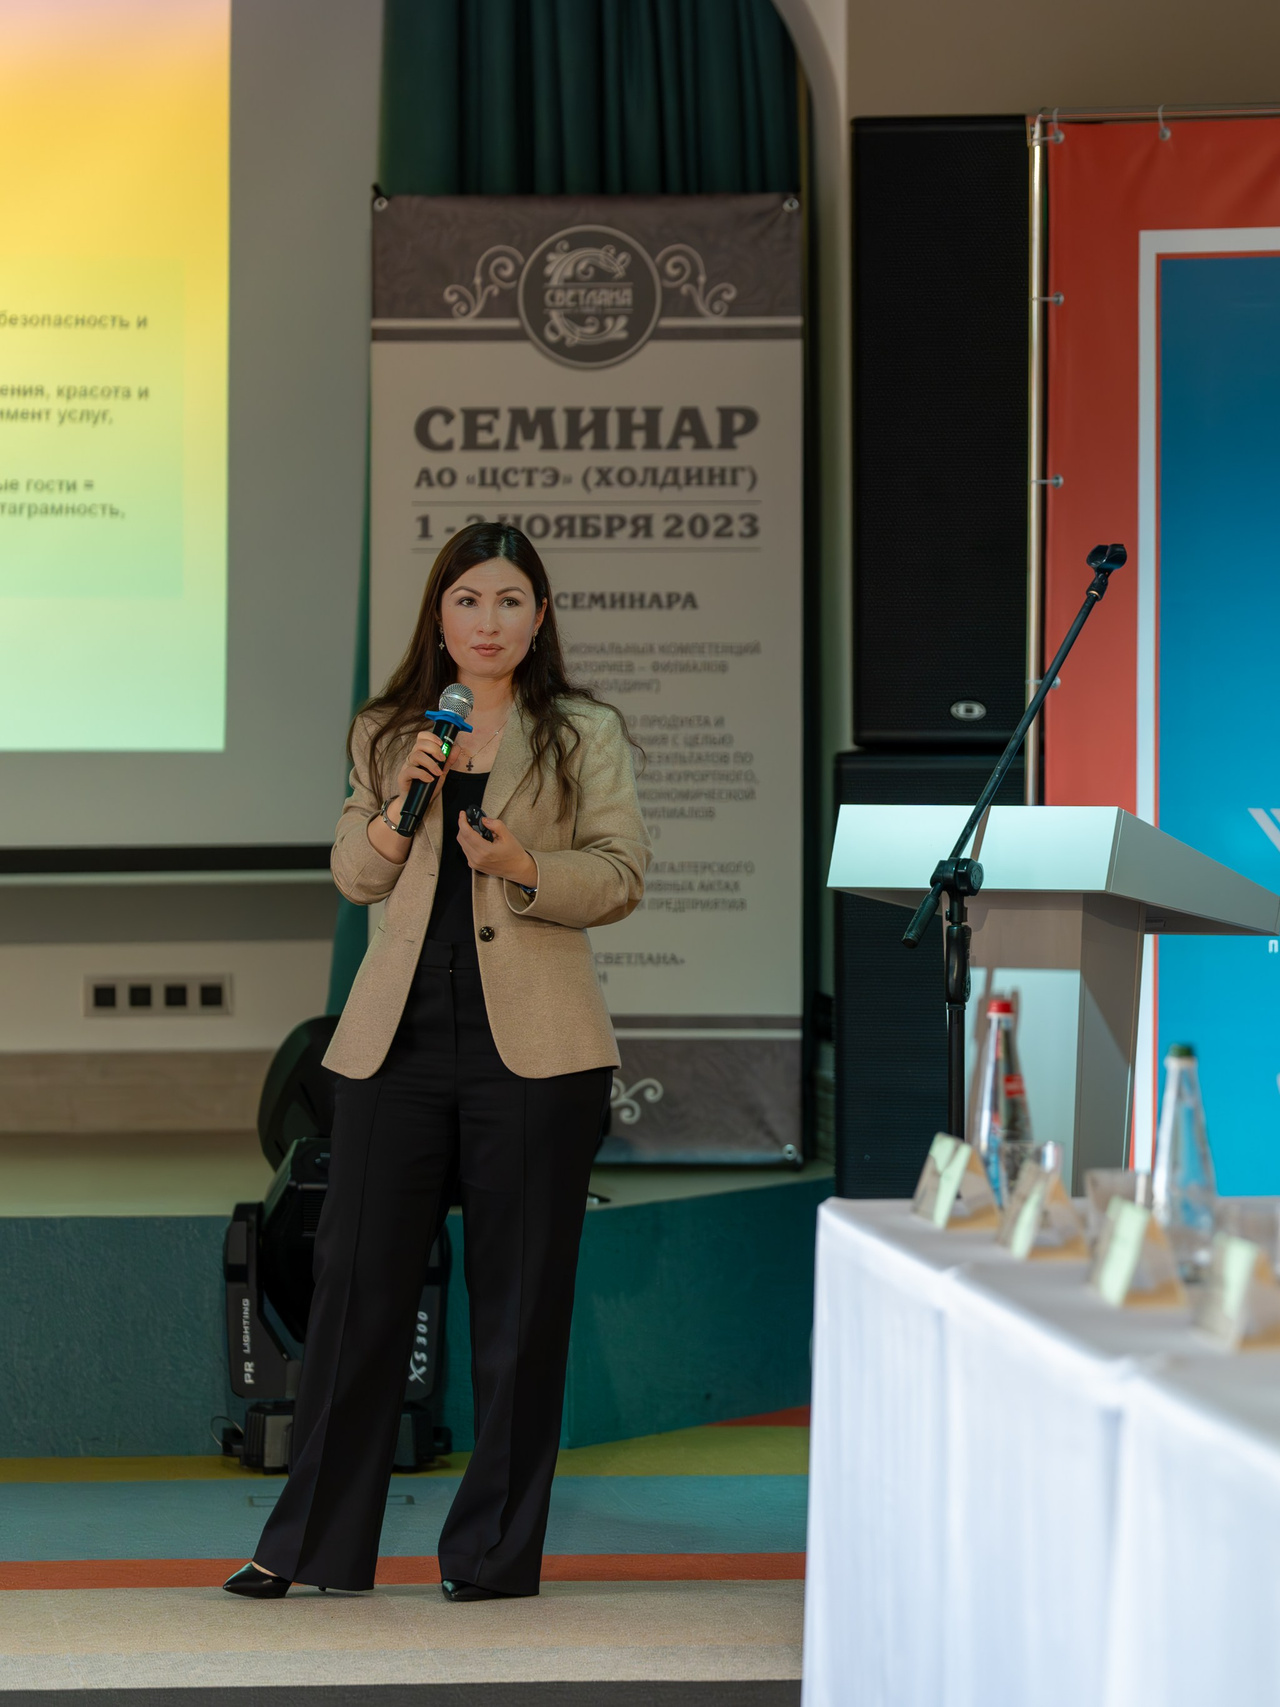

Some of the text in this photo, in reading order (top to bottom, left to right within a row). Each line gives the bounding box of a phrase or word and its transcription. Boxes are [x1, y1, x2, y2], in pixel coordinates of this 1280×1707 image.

[136, 315, 148, 328] и
[56, 386, 132, 402] красота
[137, 387, 150, 400] и
[413, 406, 760, 452] СЕМИНАР
[25, 480, 77, 493] гости
[414, 466, 759, 492] АО «ЦСТЭ» (ХОЛДИНГ)
[415, 515, 432, 539] 1
[662, 514, 761, 540] 2023
[554, 592, 698, 610] СЕМИНАРА
[241, 1298, 255, 1384] PR LIGHTING
[408, 1310, 429, 1385] XS 300
